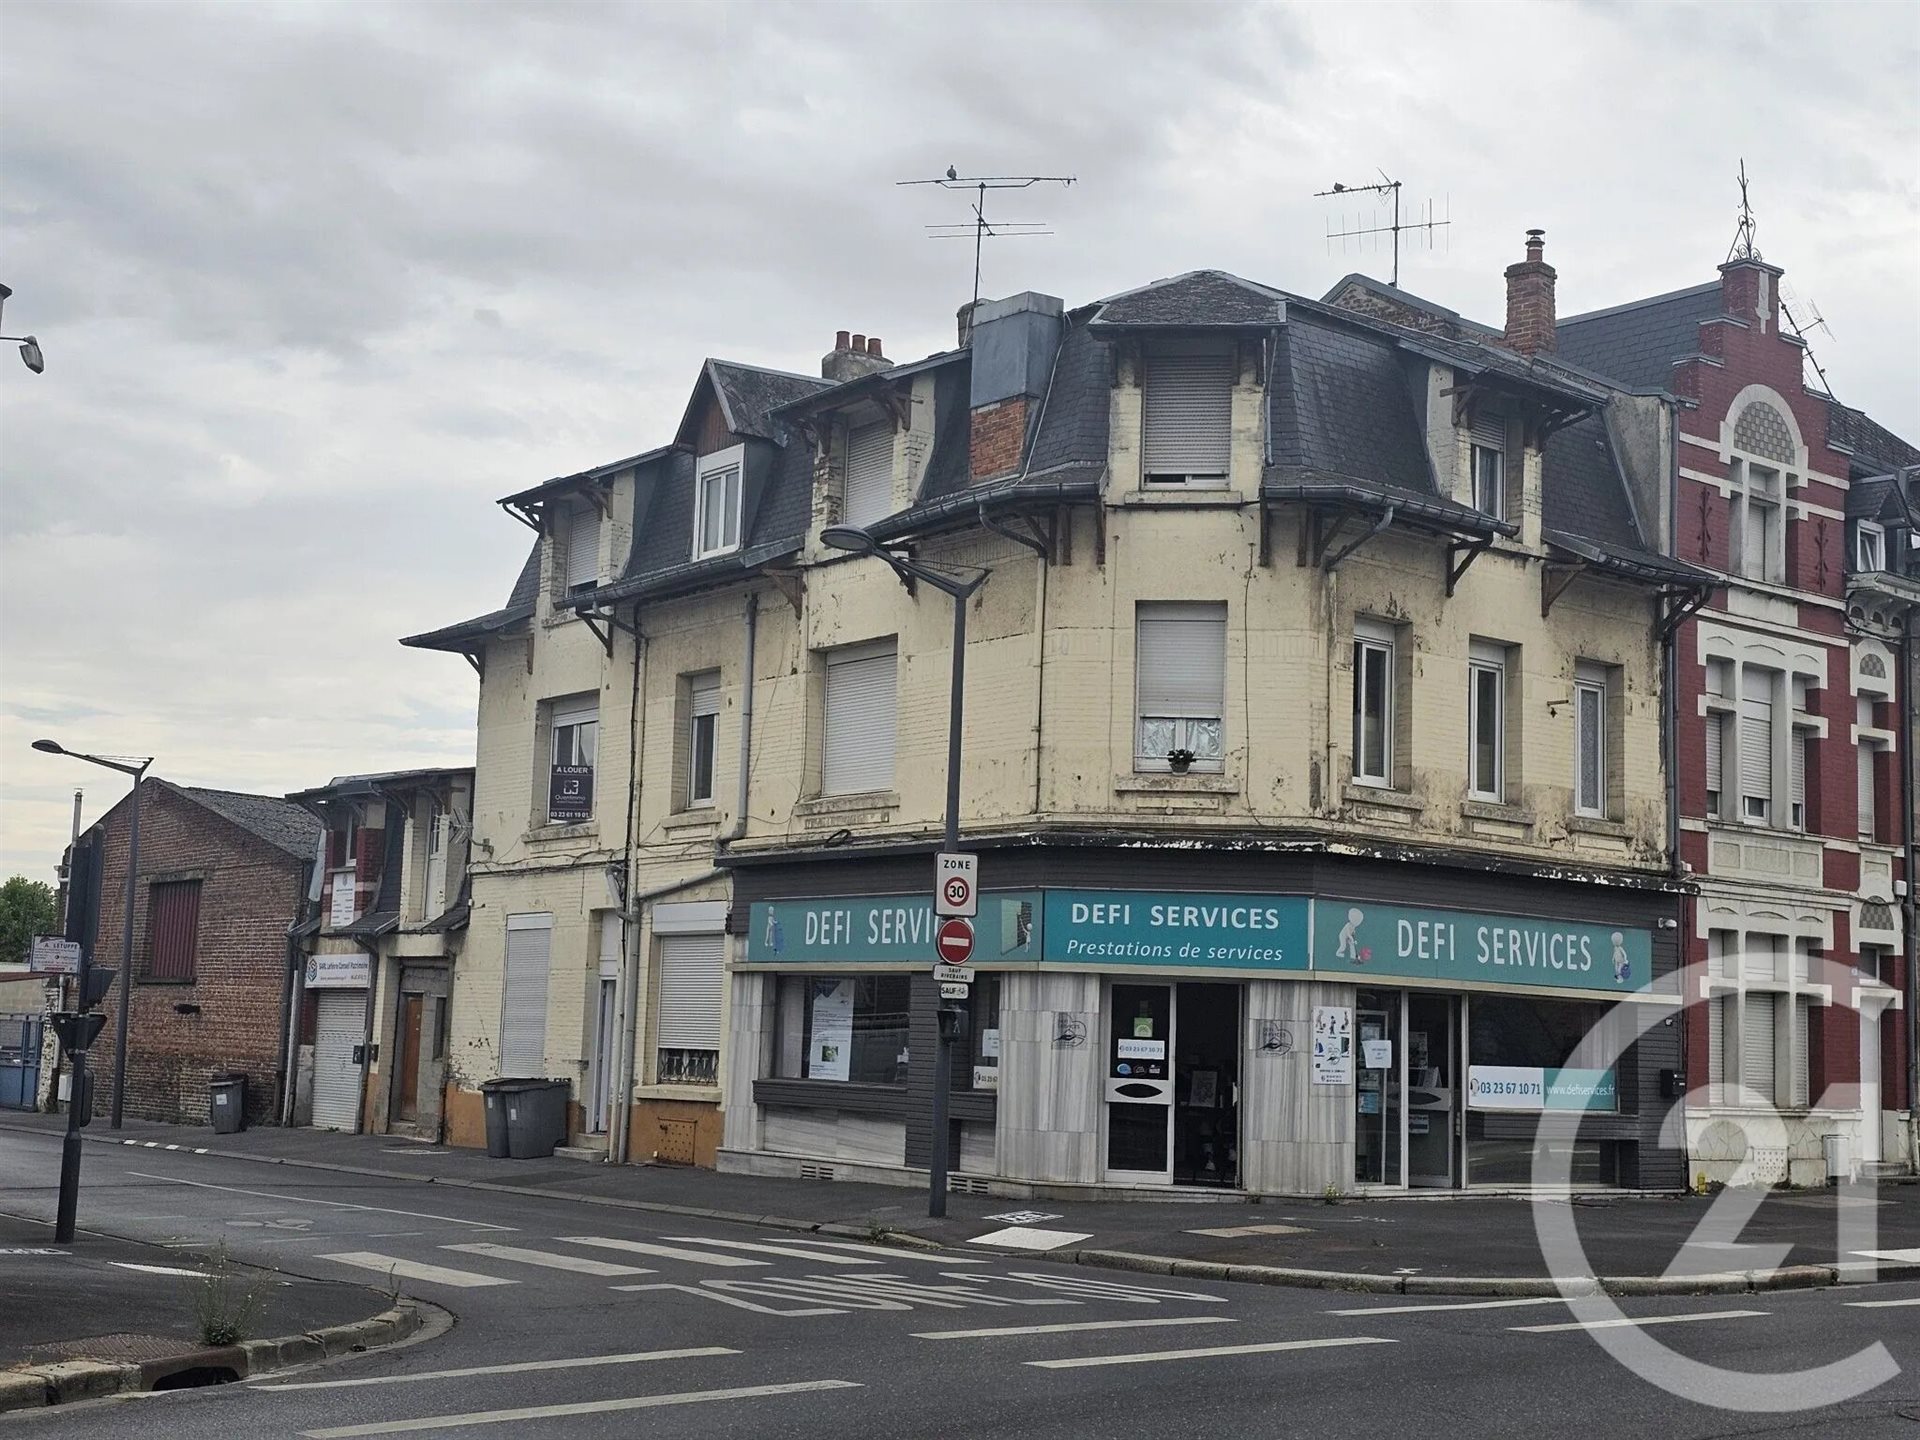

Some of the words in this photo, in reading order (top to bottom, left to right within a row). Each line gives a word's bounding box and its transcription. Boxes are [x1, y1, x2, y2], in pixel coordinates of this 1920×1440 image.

[563, 766, 588, 774] LOUER
[943, 860, 971, 870] ZONE
[949, 885, 965, 899] 30
[1071, 903, 1130, 925] DEFI
[1150, 905, 1279, 930] SERVICES
[804, 910, 851, 946] DEFI
[1067, 939, 1172, 957] Prestations
[1179, 943, 1201, 958] de
[1207, 945, 1283, 961] services
[1398, 919, 1455, 961] DEFI
[1477, 926, 1592, 972] SERVICES
[1480, 1082, 1490, 1094] 03
[1493, 1082, 1503, 1094] 23
[1506, 1083, 1516, 1095] 67
[1519, 1083, 1529, 1095] 10
[1531, 1083, 1540, 1095] 71
[1547, 1083, 1616, 1096] www.defiservices.fr
